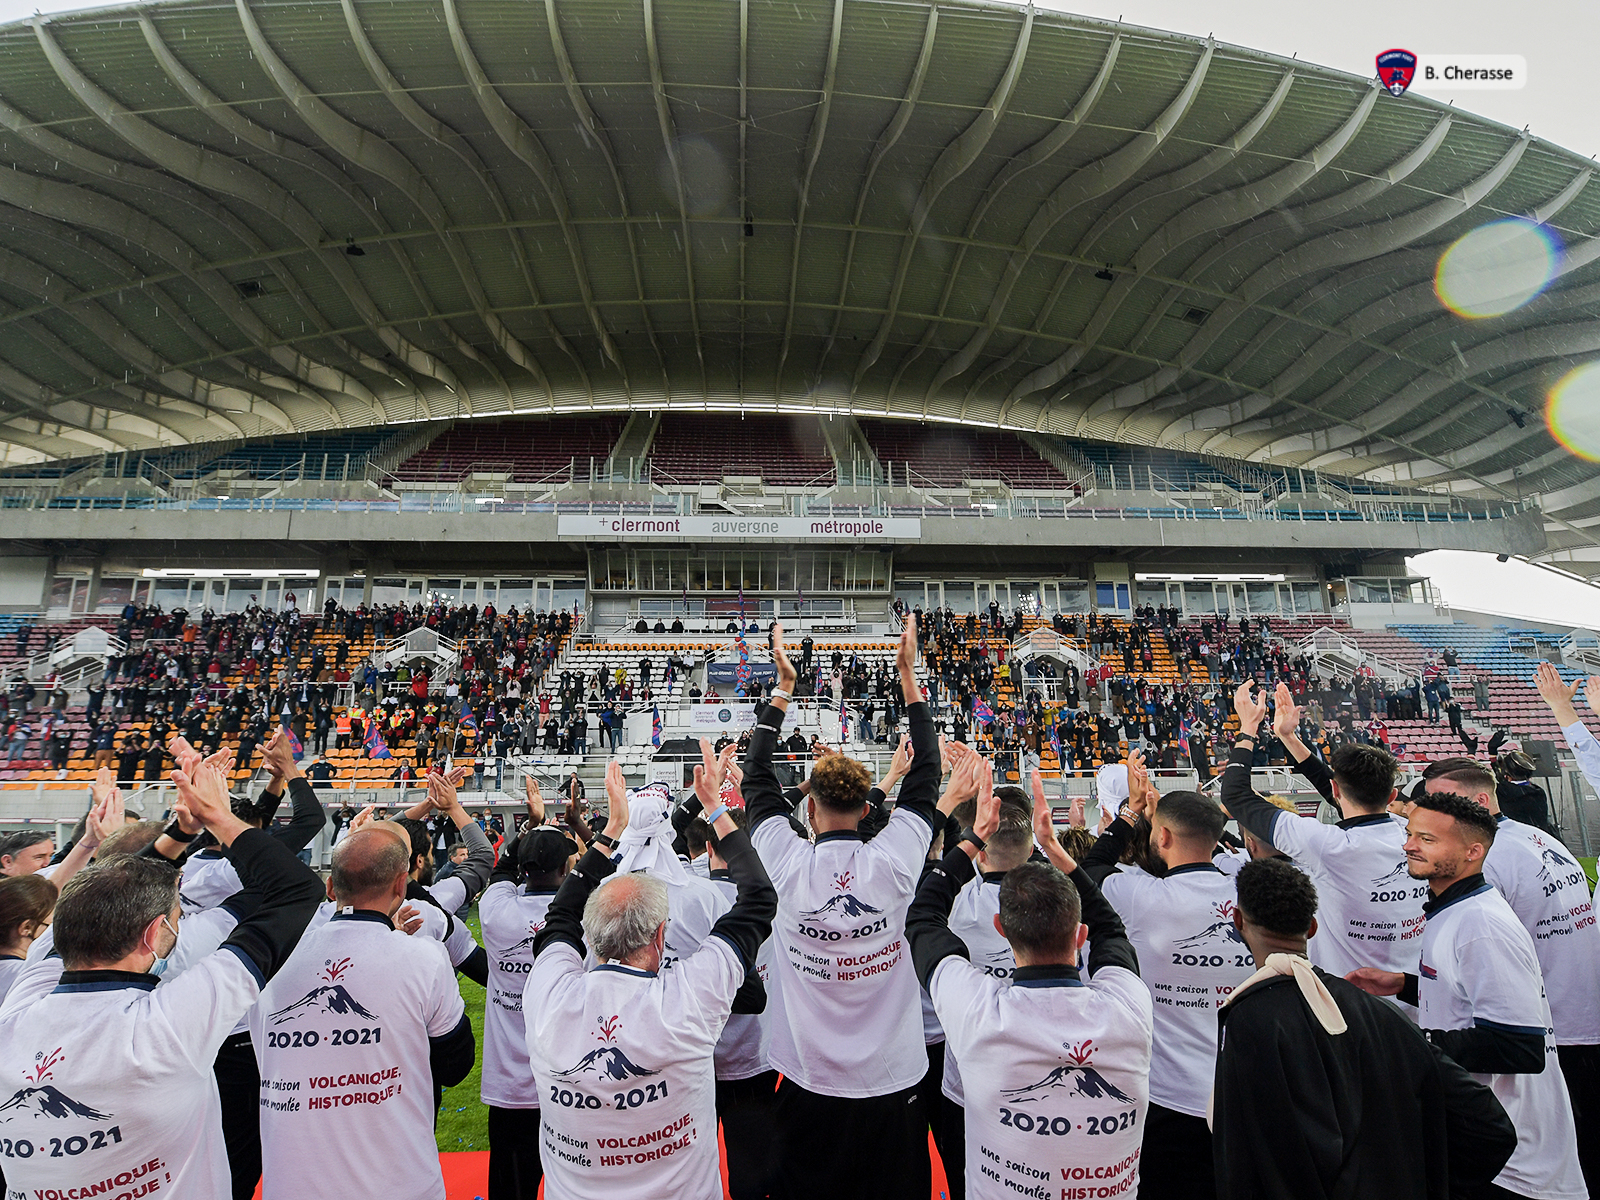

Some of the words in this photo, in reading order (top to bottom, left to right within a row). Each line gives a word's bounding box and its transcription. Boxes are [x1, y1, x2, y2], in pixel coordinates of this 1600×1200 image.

[712, 521, 779, 534] auvergne
[810, 520, 883, 536] métropole
[1370, 890, 1406, 902] 2020
[1413, 884, 1429, 898] 202
[799, 923, 841, 941] 2020
[851, 917, 888, 939] 2021
[1350, 919, 1367, 928] une
[1370, 921, 1397, 929] saison
[1348, 931, 1364, 940] une
[499, 961, 532, 973] 2020
[1172, 953, 1224, 967] 2020
[1234, 955, 1255, 967] 20
[803, 964, 831, 980] montée
[984, 965, 1016, 979] 202
[1154, 982, 1172, 991] une
[1176, 984, 1208, 994] saison
[1155, 995, 1172, 1006] une
[1176, 998, 1209, 1008] montée
[268, 1030, 320, 1048] 2020
[331, 1027, 381, 1046] 2021
[551, 1085, 602, 1109] 2020
[613, 1080, 668, 1110] 2021
[999, 1108, 1071, 1136] 2020
[1086, 1109, 1137, 1135] 2021
[50, 1126, 122, 1157] 2021
[557, 1132, 588, 1149] saison
[558, 1150, 592, 1167] montée
[981, 1145, 1000, 1164] une
[1005, 1159, 1051, 1182] saison
[981, 1164, 1000, 1183] une
[1004, 1177, 1052, 1200] montée
